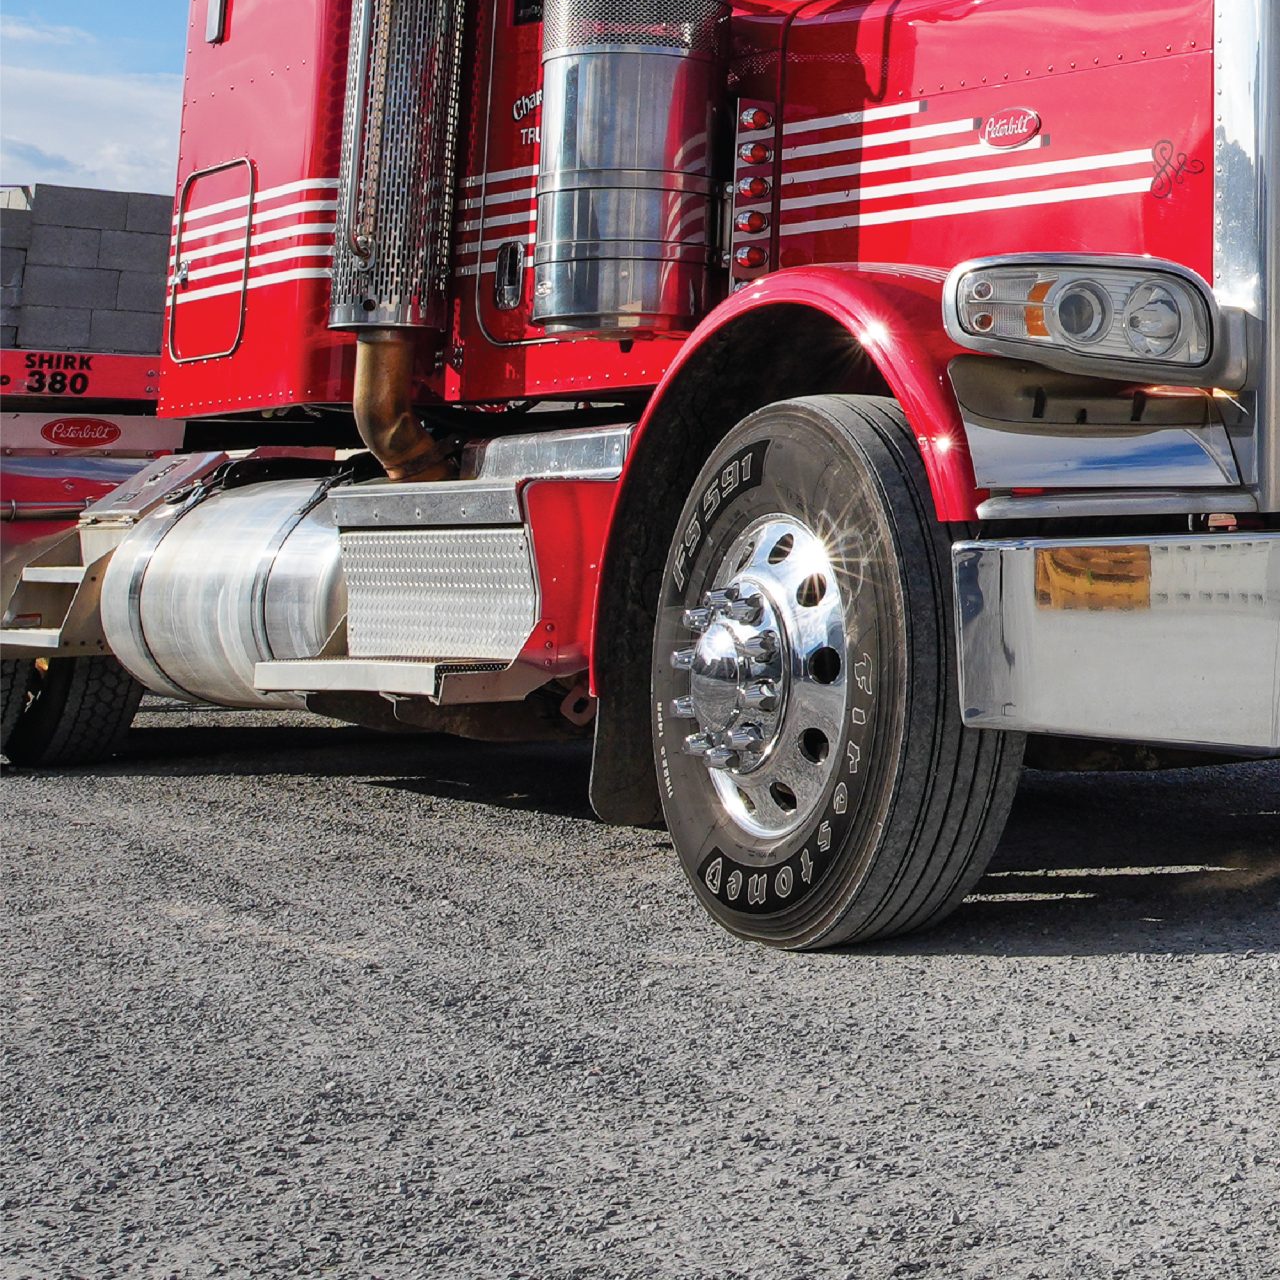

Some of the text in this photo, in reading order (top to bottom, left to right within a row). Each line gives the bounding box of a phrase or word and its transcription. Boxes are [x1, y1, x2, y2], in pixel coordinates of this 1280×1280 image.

[984, 114, 1035, 140] Peterbilt
[25, 353, 94, 371] SHIRK
[26, 371, 89, 395] 380
[51, 422, 114, 439] Peterbilt
[672, 452, 753, 593] FS 591
